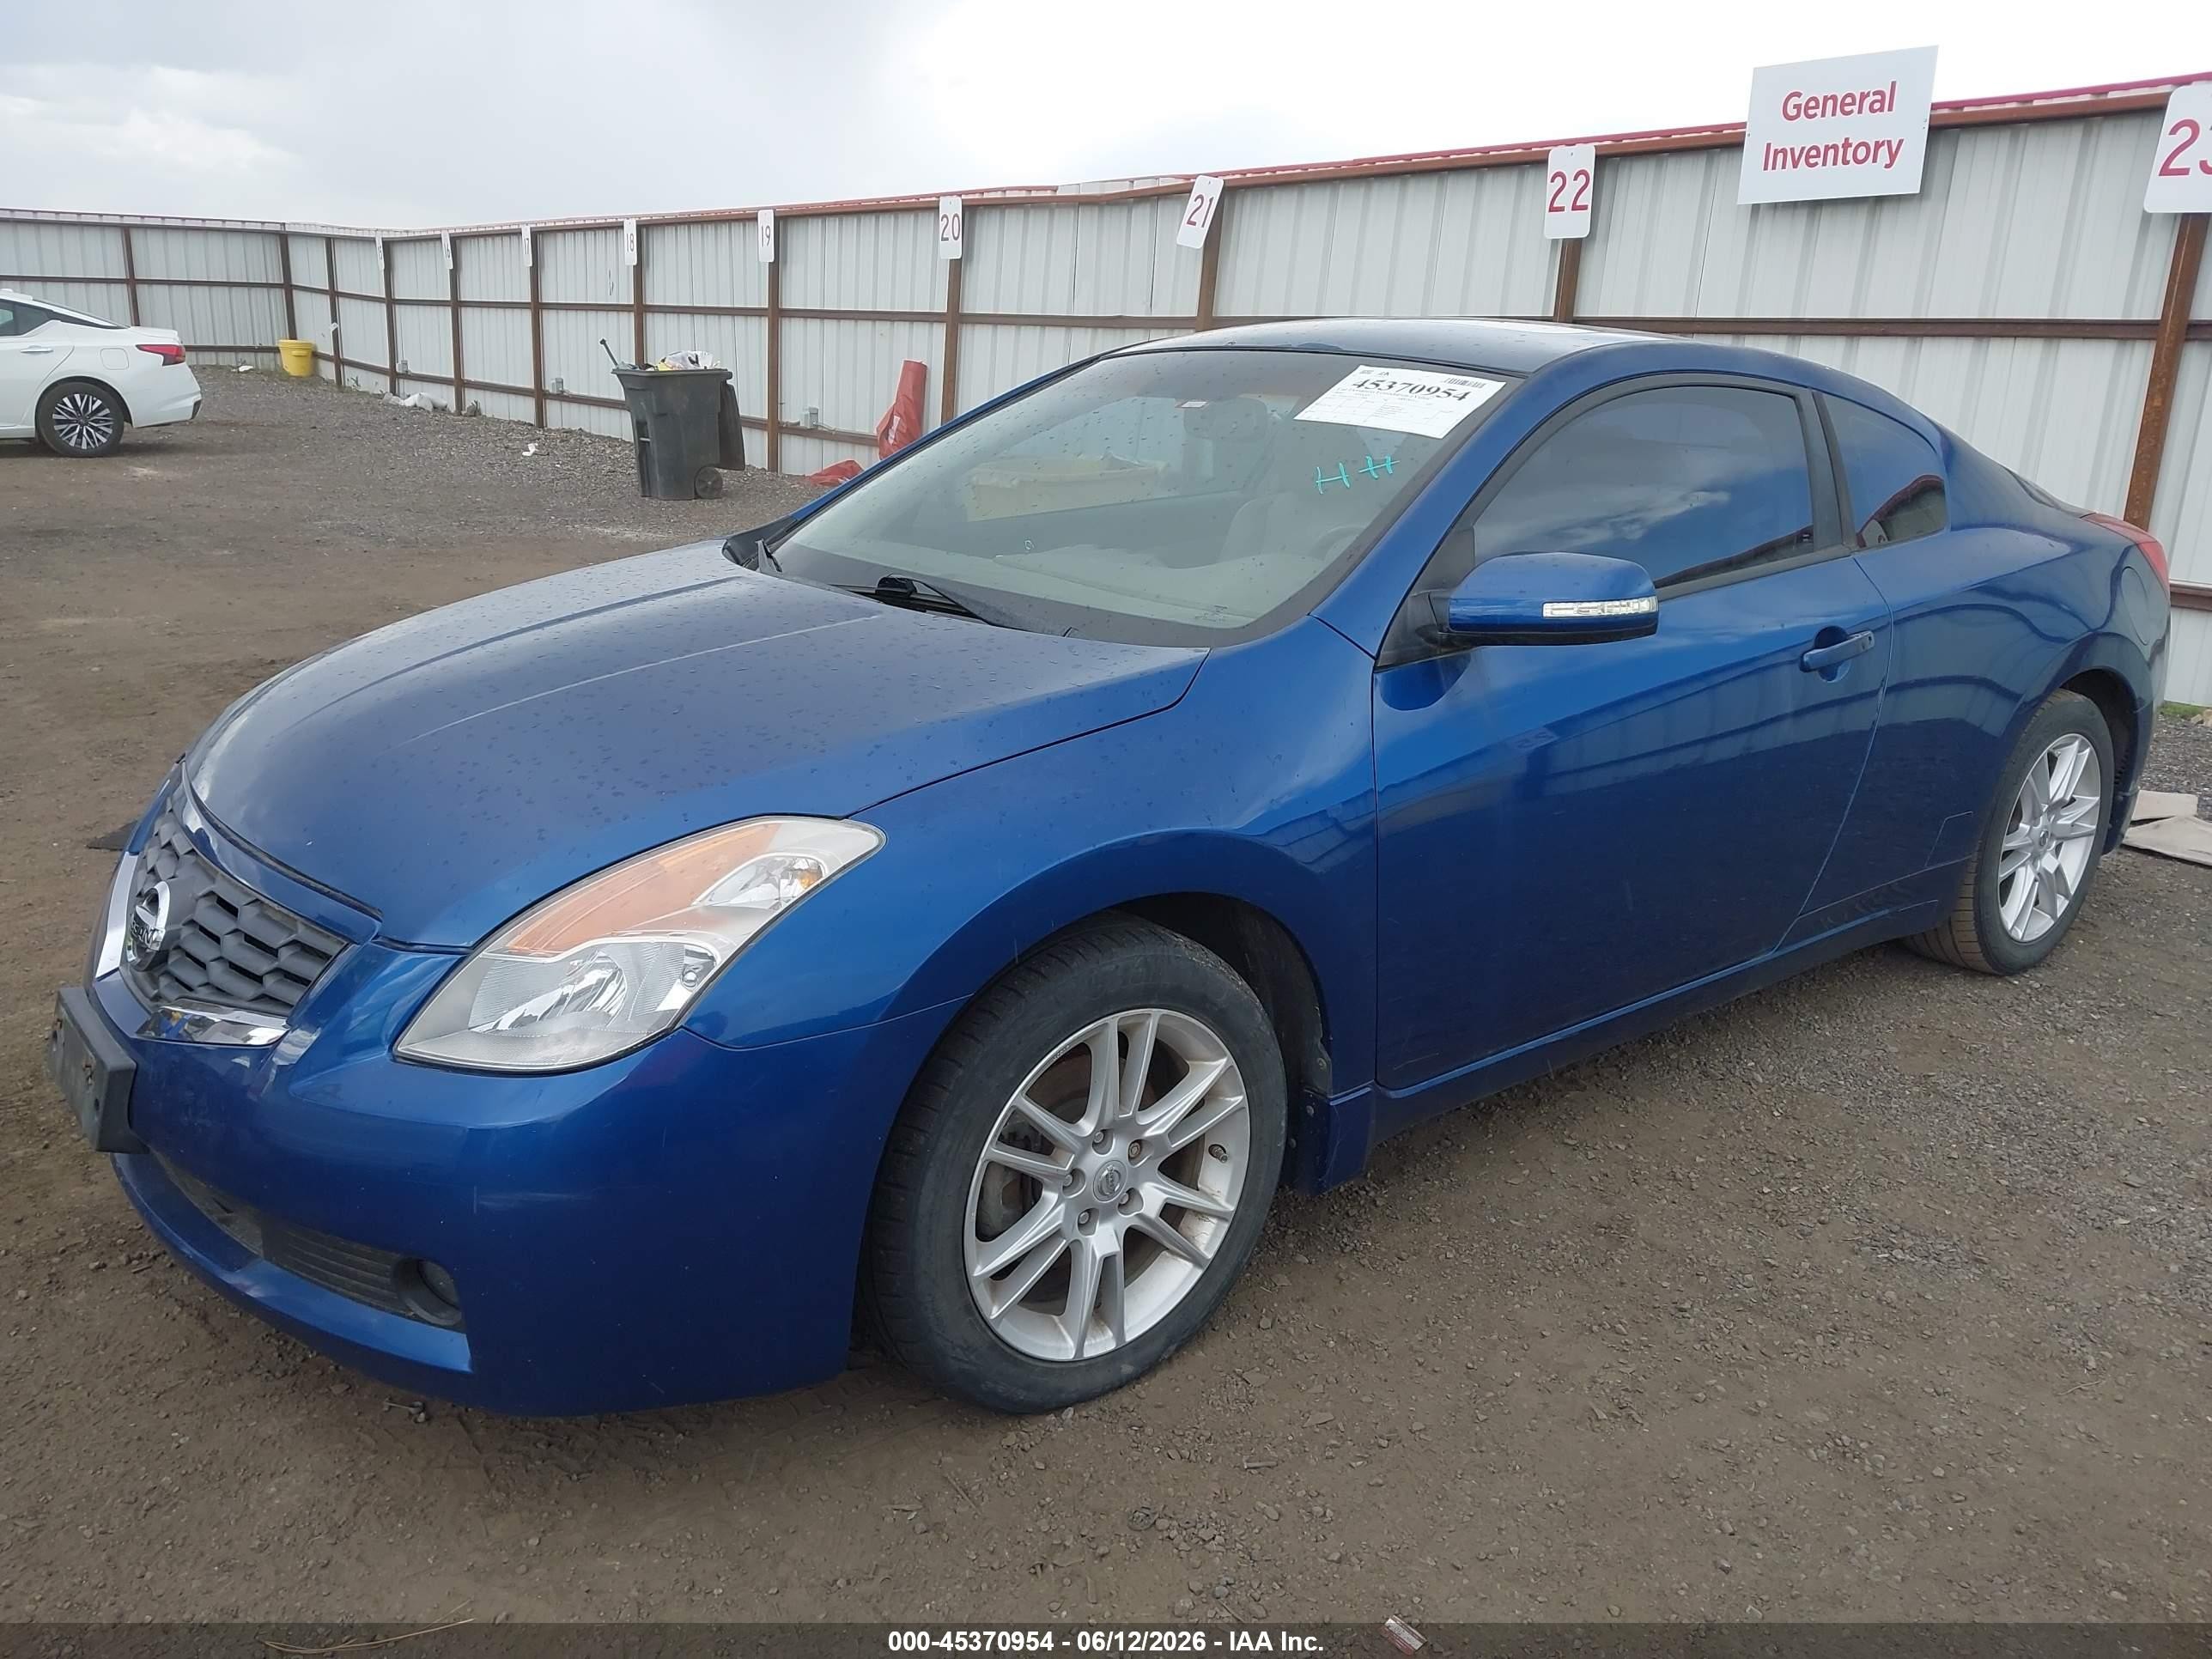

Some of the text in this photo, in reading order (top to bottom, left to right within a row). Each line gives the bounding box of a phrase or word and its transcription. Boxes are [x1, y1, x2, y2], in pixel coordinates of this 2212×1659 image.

[1782, 81, 1897, 121] General
[1762, 137, 1905, 172] Inventory
[1548, 169, 1590, 212] 22
[1187, 194, 1214, 228] 21
[761, 225, 771, 247] 19
[940, 213, 961, 241] 20
[524, 237, 531, 255] 17
[626, 233, 635, 252] 18
[1352, 379, 1471, 401] 45370954
